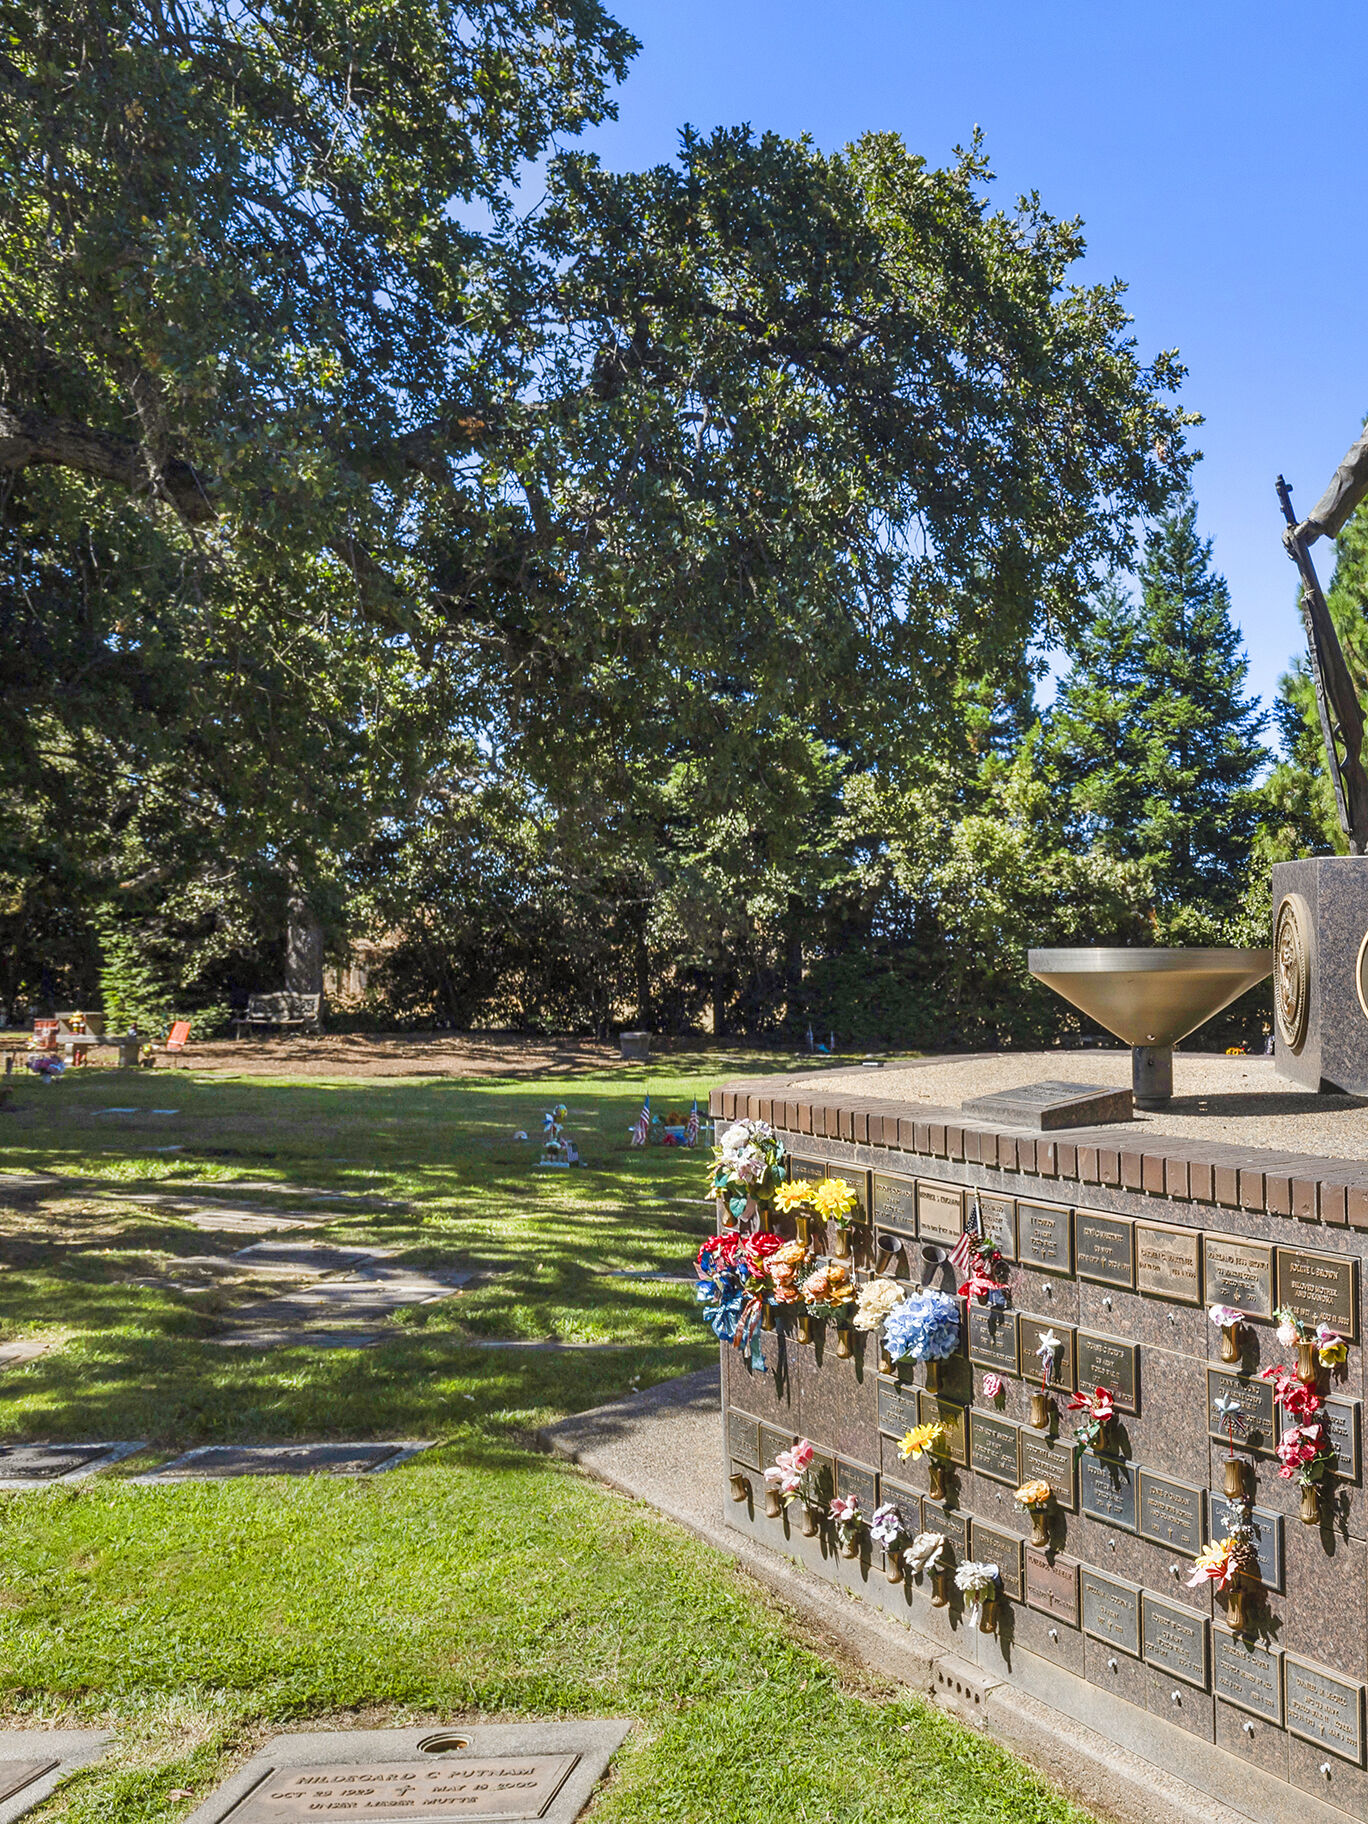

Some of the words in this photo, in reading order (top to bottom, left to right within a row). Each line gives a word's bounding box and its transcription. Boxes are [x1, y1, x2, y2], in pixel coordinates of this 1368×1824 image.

[1316, 1267, 1338, 1280] BROWN
[1292, 1281, 1314, 1291] BELOVED
[1316, 1285, 1337, 1297] MOTHER
[1296, 1290, 1306, 1298] AND
[296, 1773, 416, 1784] HILDEGARD
[448, 1768, 535, 1779] PUTNAM
[498, 1782, 537, 1790] 2000
